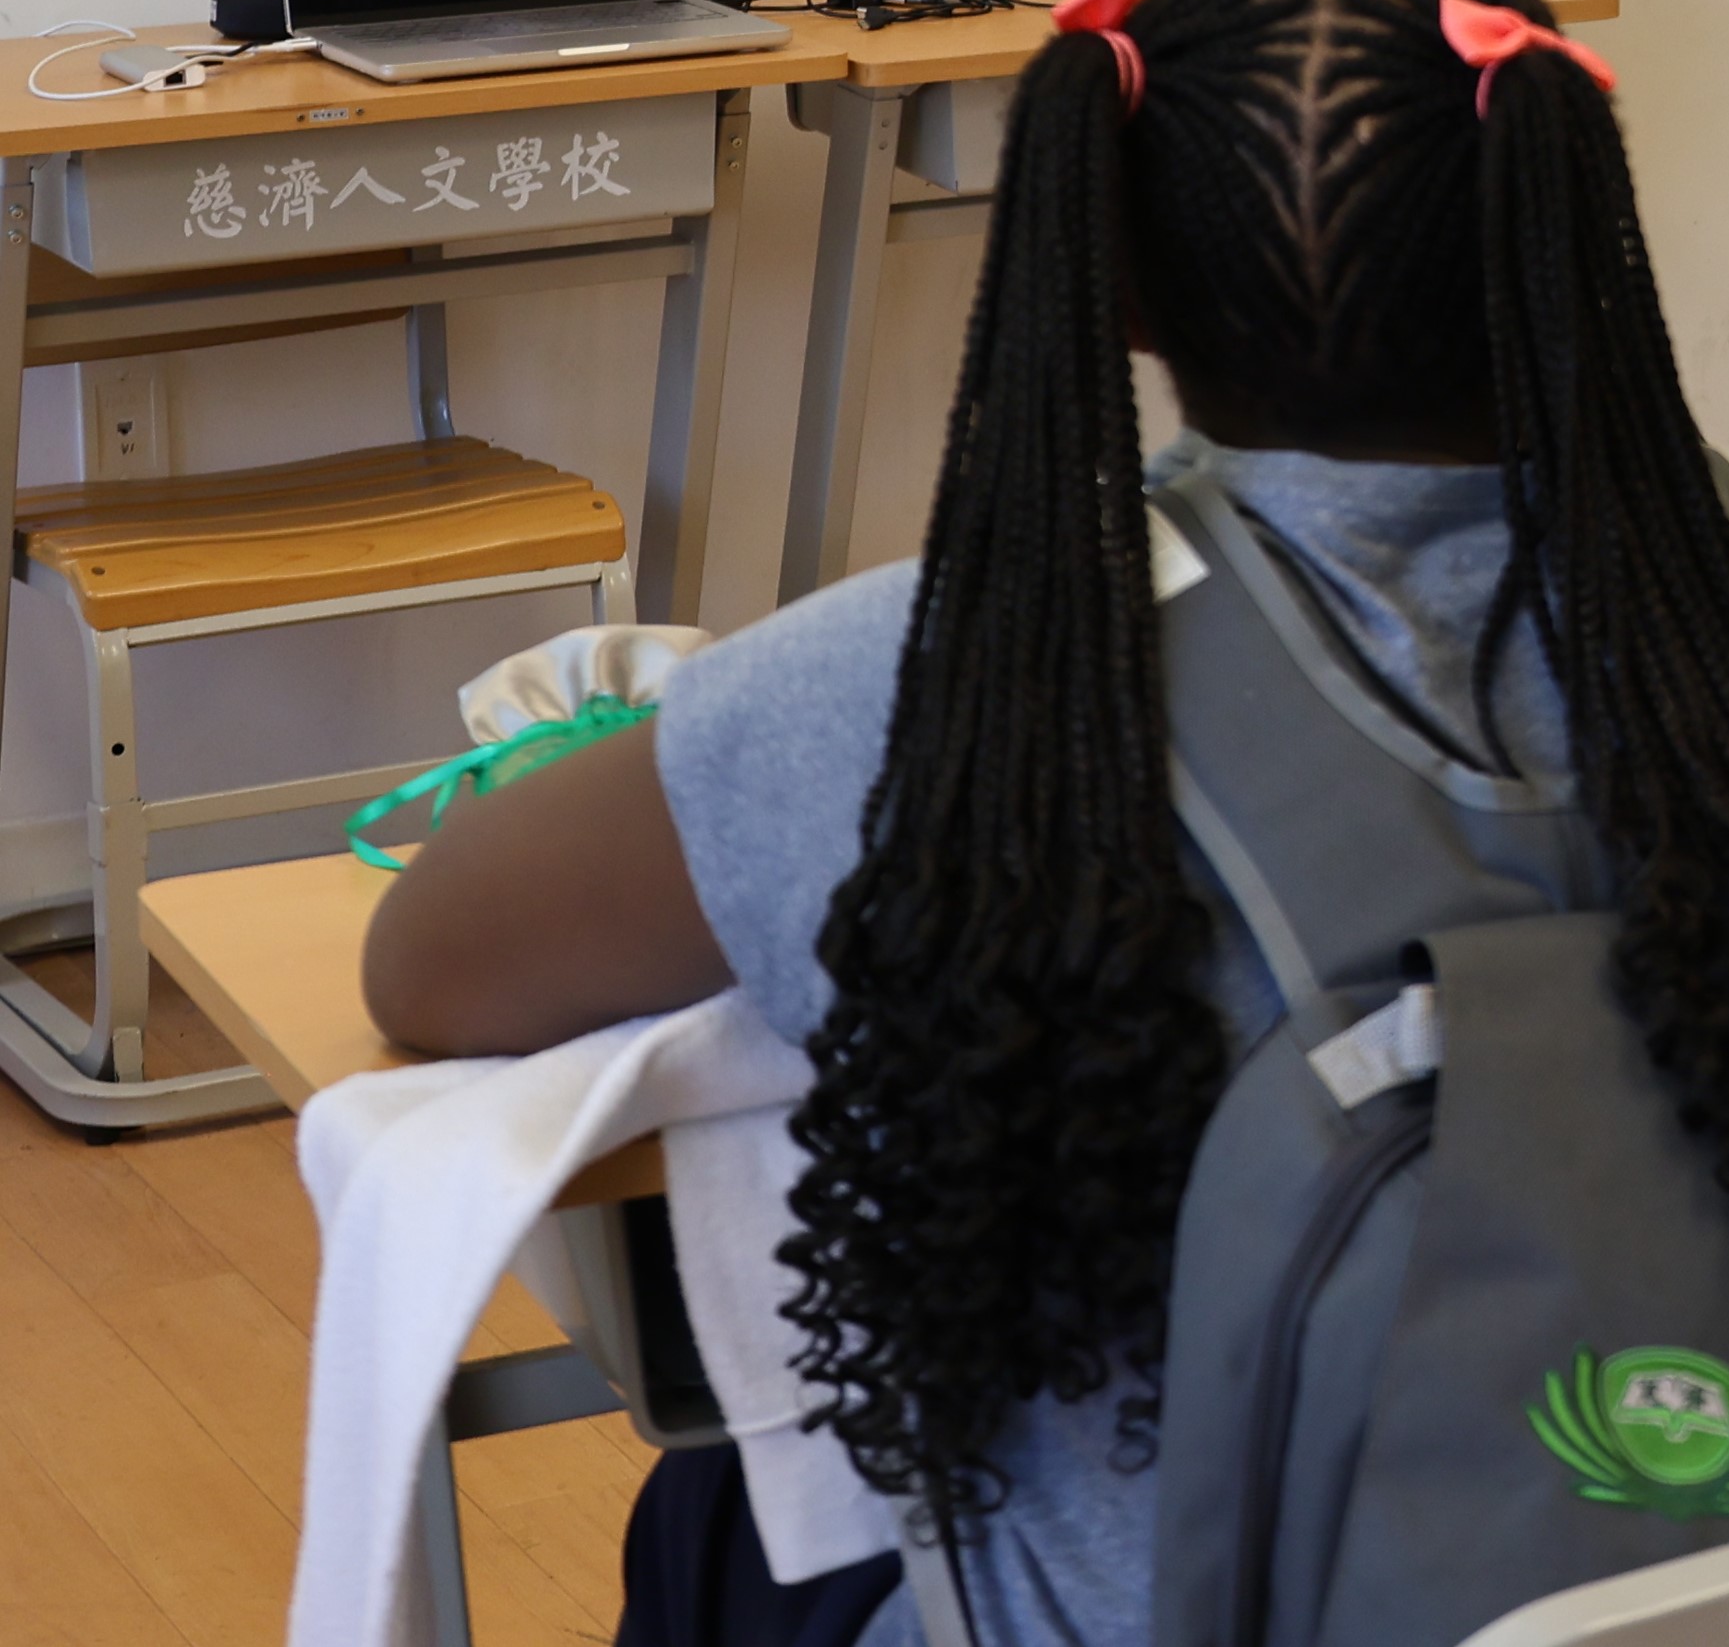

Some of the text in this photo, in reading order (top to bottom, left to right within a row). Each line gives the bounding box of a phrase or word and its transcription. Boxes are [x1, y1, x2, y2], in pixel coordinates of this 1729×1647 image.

[182, 130, 632, 240] 慈濟人文學校
